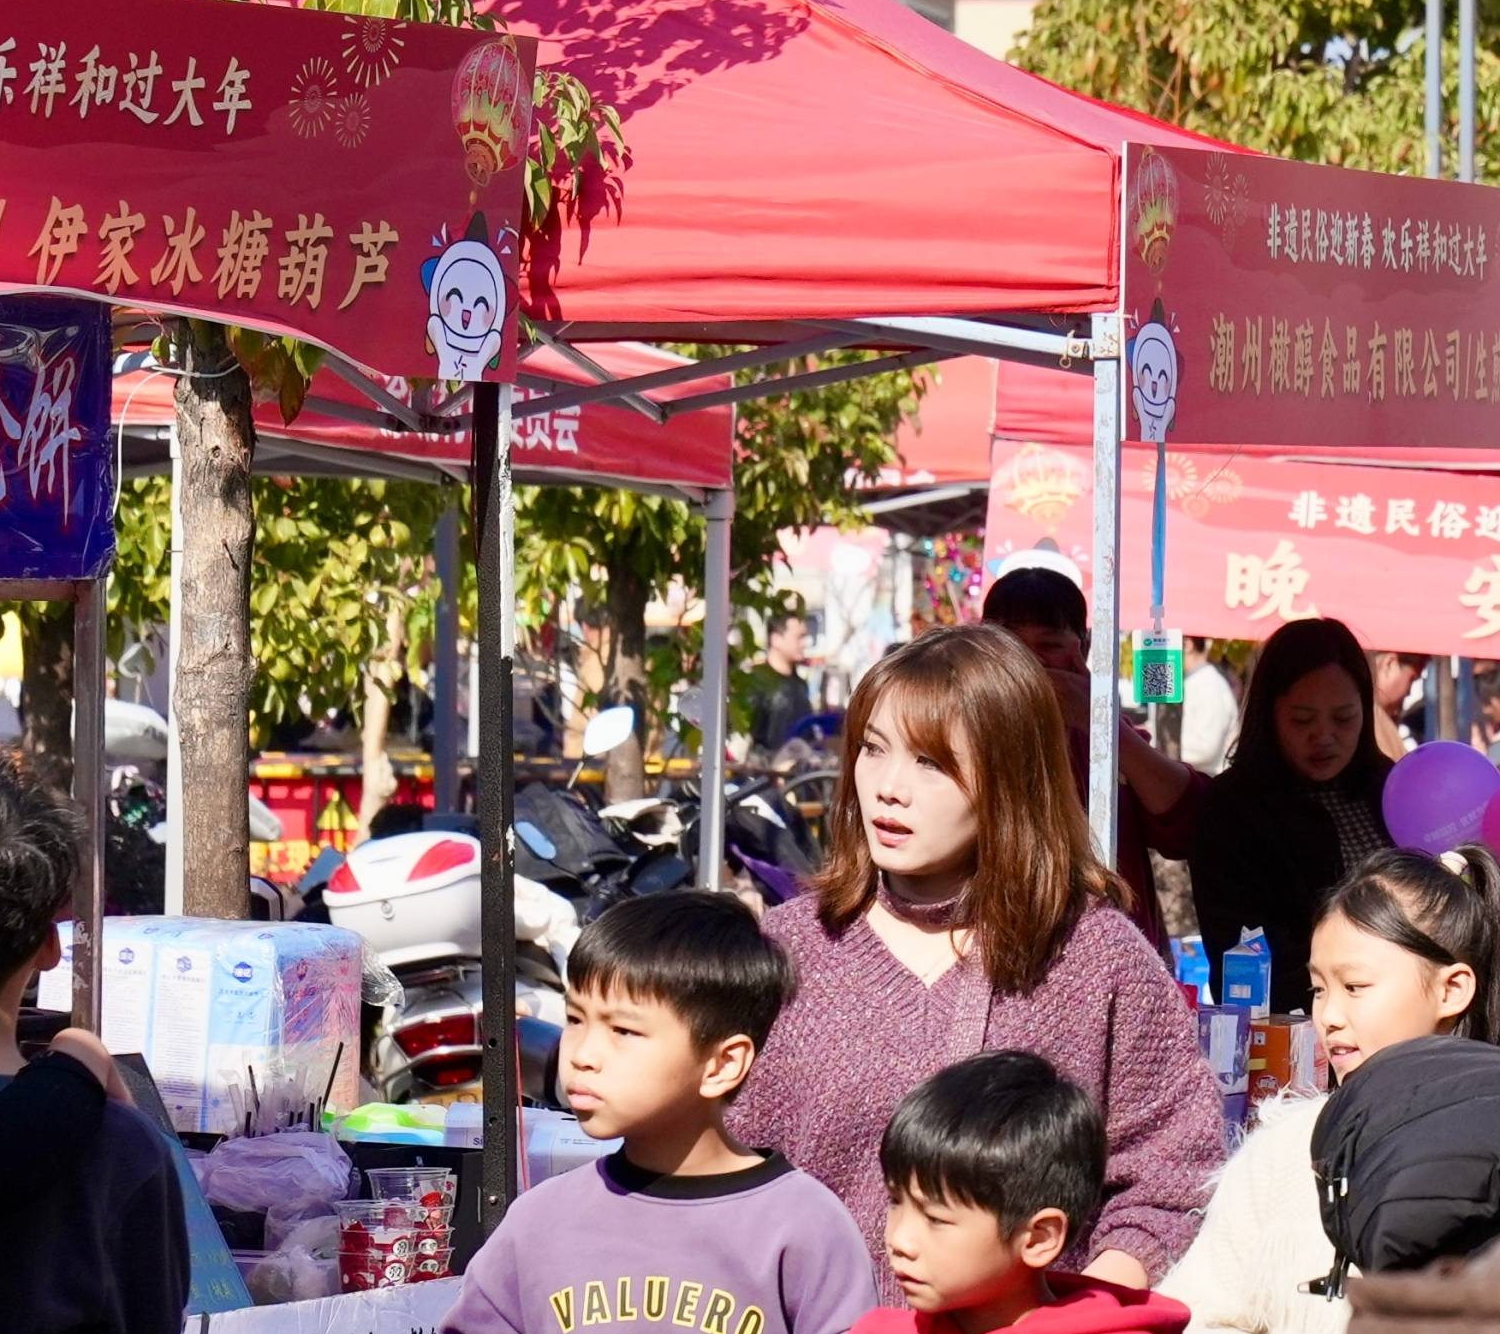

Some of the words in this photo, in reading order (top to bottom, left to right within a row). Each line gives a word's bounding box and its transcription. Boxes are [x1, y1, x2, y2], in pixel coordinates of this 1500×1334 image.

[26, 195, 399, 312] 伊家冰糖葫芦
[1266, 203, 1375, 270] 非遗民俗迎新春
[1381, 221, 1488, 281] 欢乐祥和过大年
